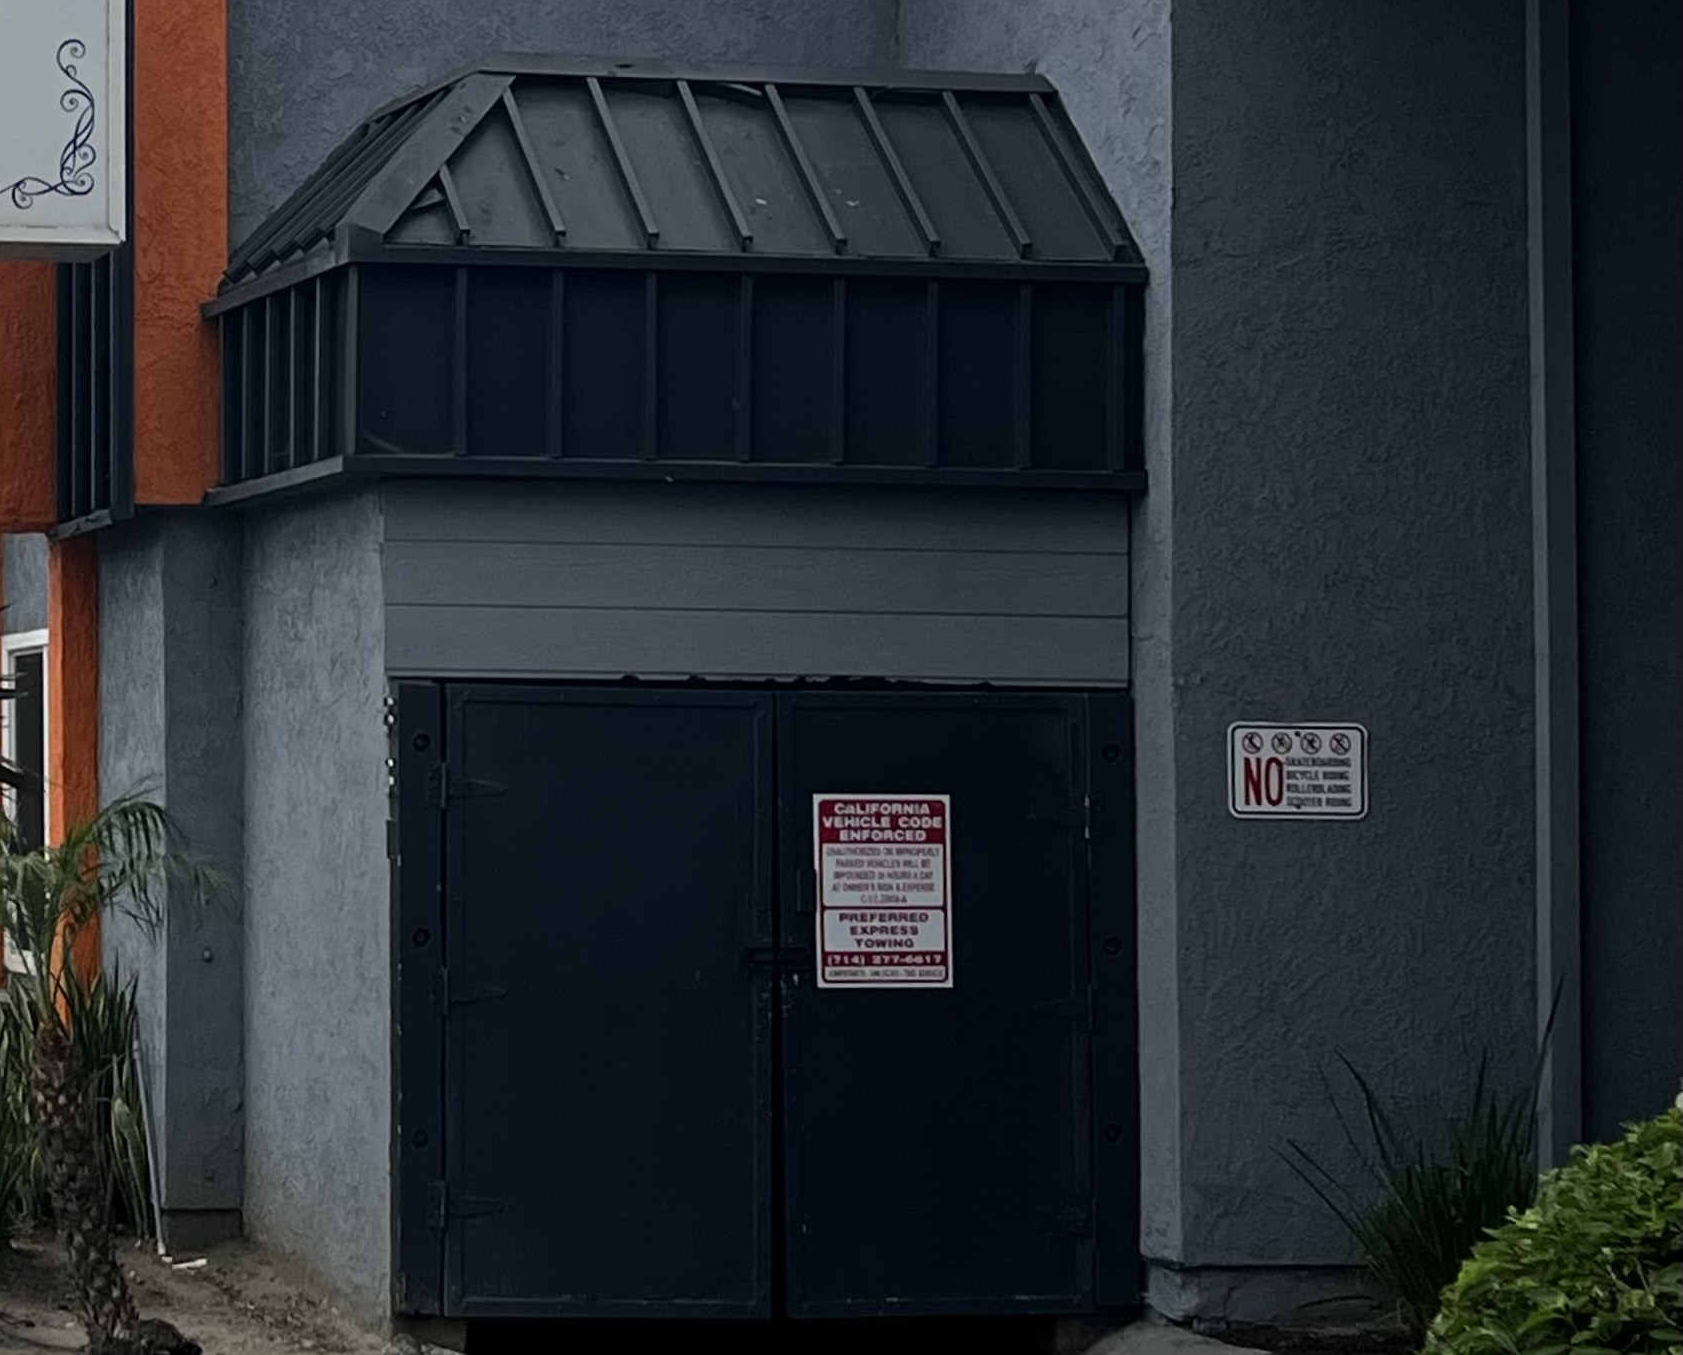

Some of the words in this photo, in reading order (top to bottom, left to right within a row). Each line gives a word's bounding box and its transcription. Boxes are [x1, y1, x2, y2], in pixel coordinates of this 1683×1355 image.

[1243, 756, 1284, 807] NO
[834, 802, 931, 816] CALIFORNIA
[822, 816, 891, 829] VEHICLE
[898, 816, 943, 829] CODE
[839, 829, 927, 842] ENFORCED
[838, 912, 929, 923] PREFERRED
[849, 925, 919, 936] EXPRESS
[854, 938, 915, 949] TOWING
[827, 954, 866, 965] (714)
